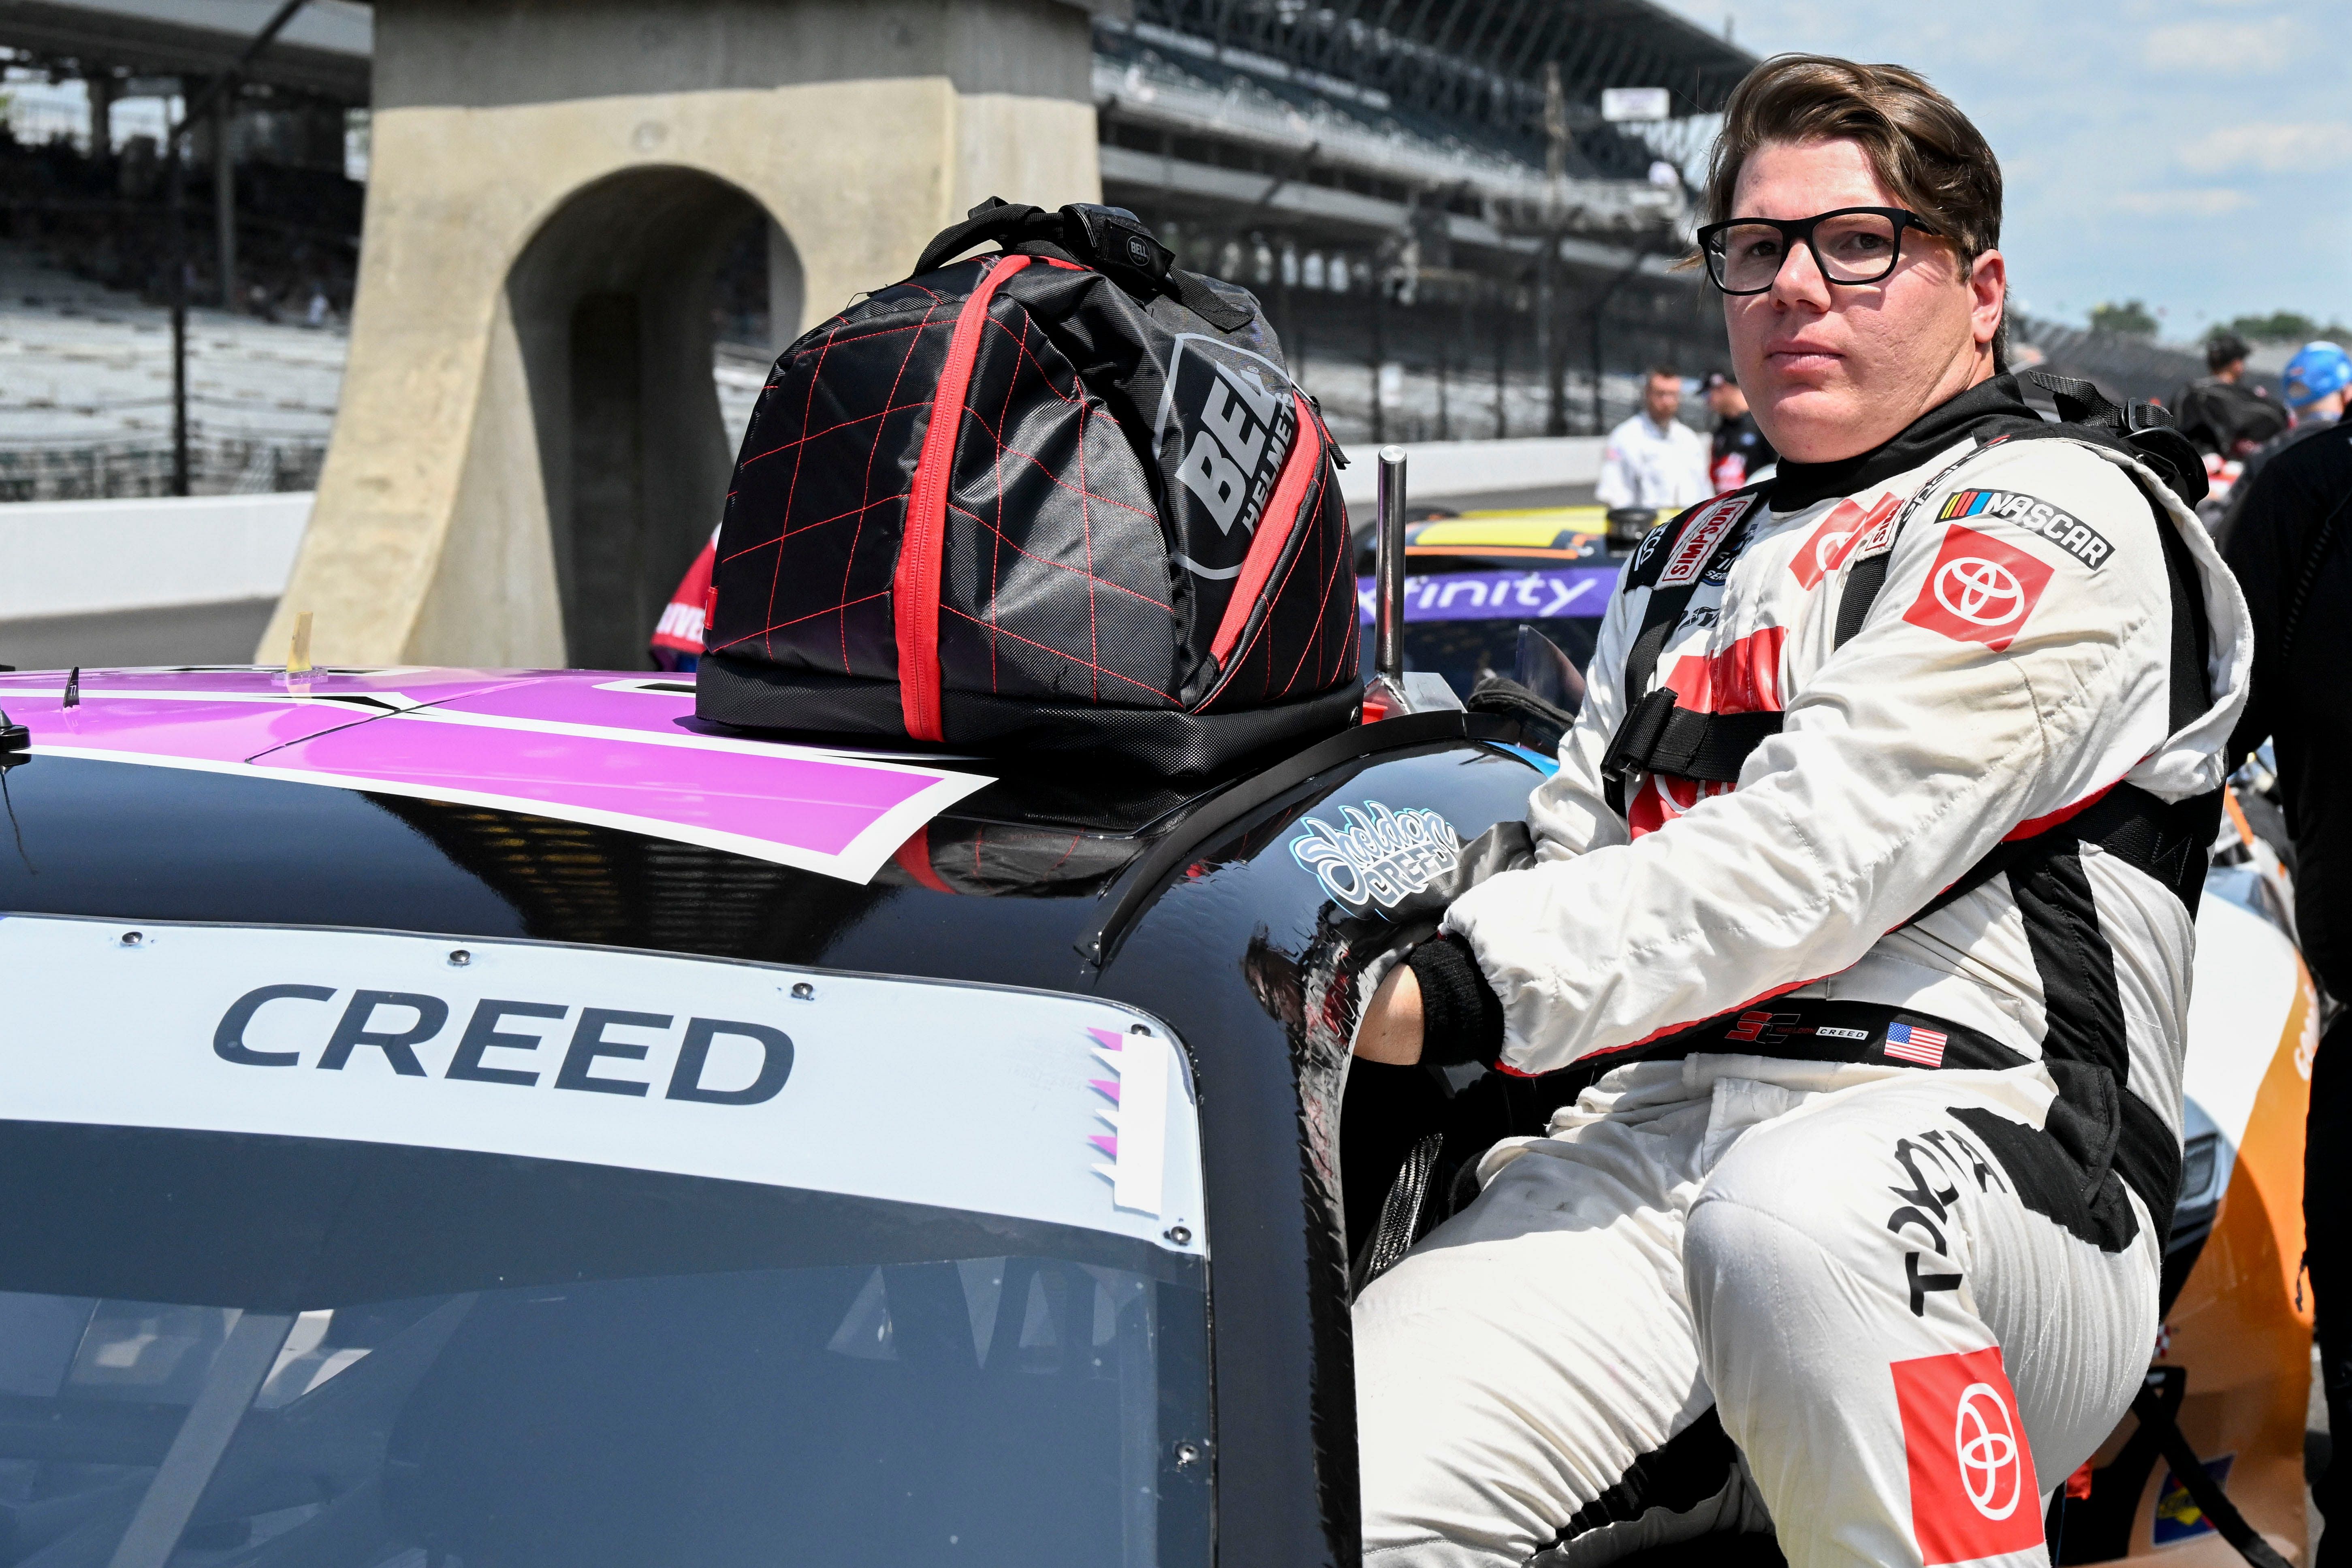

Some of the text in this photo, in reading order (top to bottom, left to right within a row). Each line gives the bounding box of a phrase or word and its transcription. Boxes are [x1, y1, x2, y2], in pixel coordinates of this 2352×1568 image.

[1131, 241, 1147, 258] BELL
[1242, 392, 1296, 536] HELMETS
[1670, 506, 1737, 576] SIMPSON
[1983, 492, 2107, 566] NASCAR
[1362, 843, 1458, 908] CREED
[213, 983, 795, 1105] CREED
[1820, 1028, 1864, 1038] CREED
